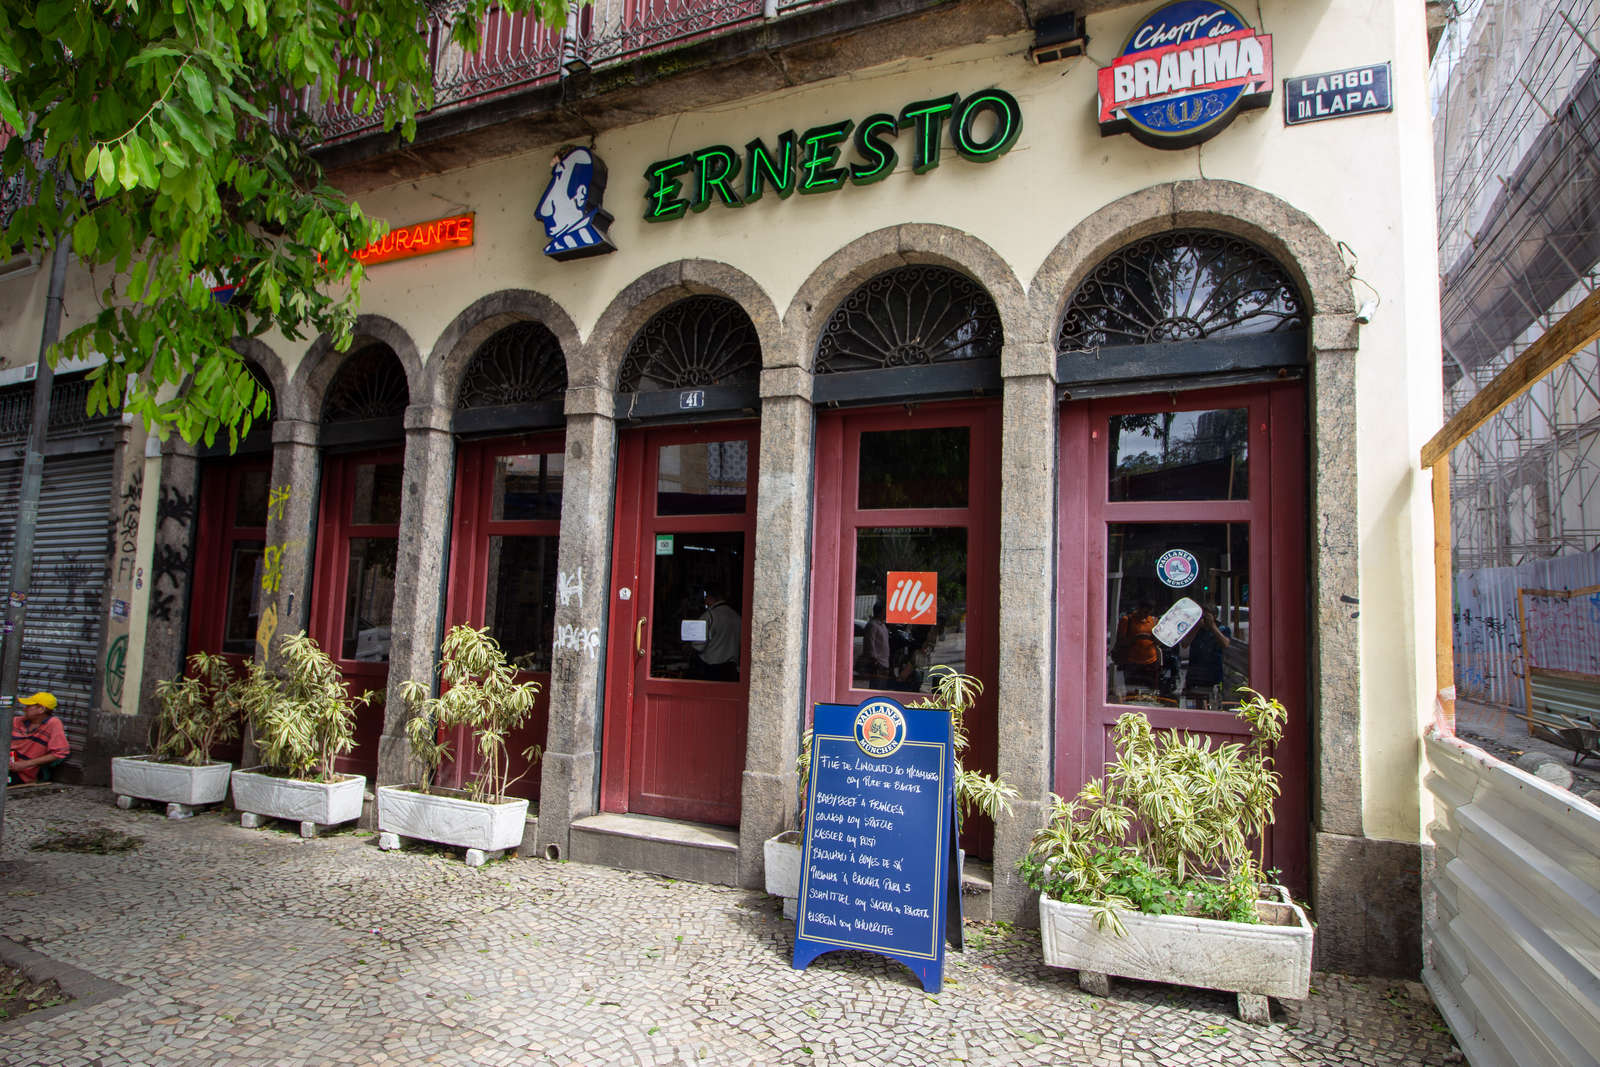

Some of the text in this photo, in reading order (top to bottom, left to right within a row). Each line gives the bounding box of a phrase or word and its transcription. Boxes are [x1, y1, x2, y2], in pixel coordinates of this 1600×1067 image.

[1134, 9, 1235, 49] Chopp da
[1114, 37, 1264, 104] BRAHMA
[1302, 69, 1373, 97] LARGO
[1298, 89, 1378, 119] DA LAPA
[643, 88, 1023, 222] ERNESTO
[686, 392, 698, 407] 41
[1159, 551, 1193, 569] PAULANER
[889, 579, 934, 620] illy
[857, 706, 902, 727] PAULANER
